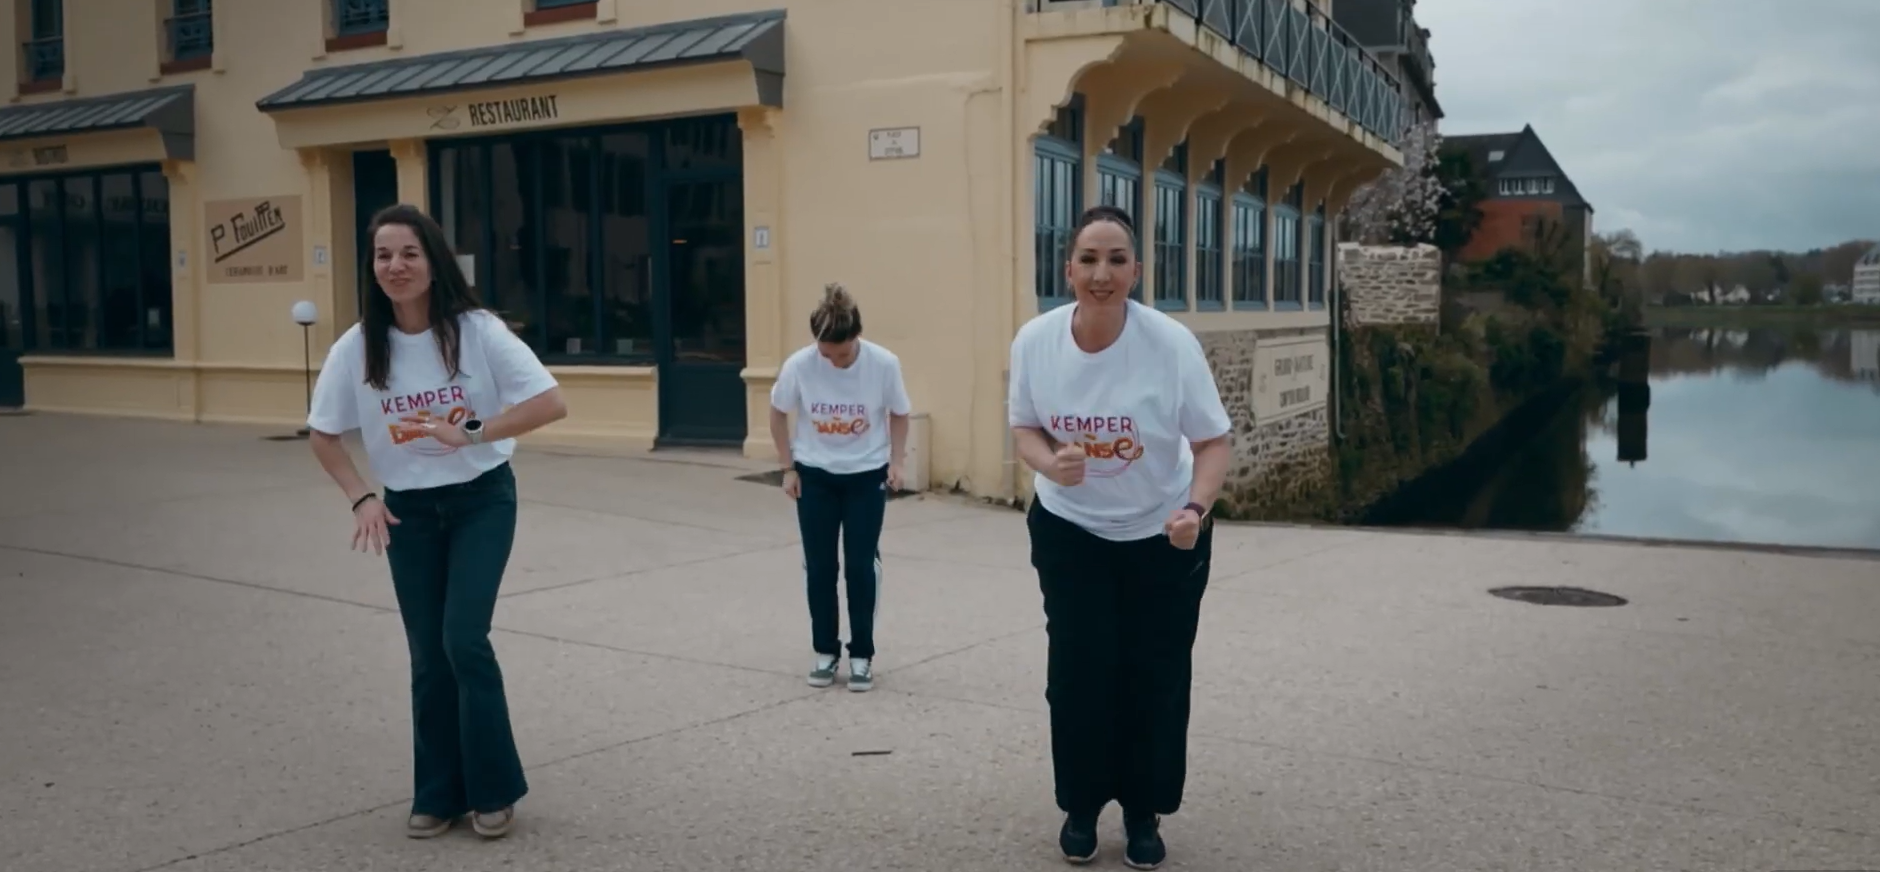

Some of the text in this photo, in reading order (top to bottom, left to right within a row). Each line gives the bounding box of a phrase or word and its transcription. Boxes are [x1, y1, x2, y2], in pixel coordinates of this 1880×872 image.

[468, 95, 558, 126] RESTAURANT
[211, 223, 225, 254] P
[381, 386, 464, 414] KEMPER
[811, 402, 865, 416] KEMPER
[1050, 415, 1132, 432] KEMPER
